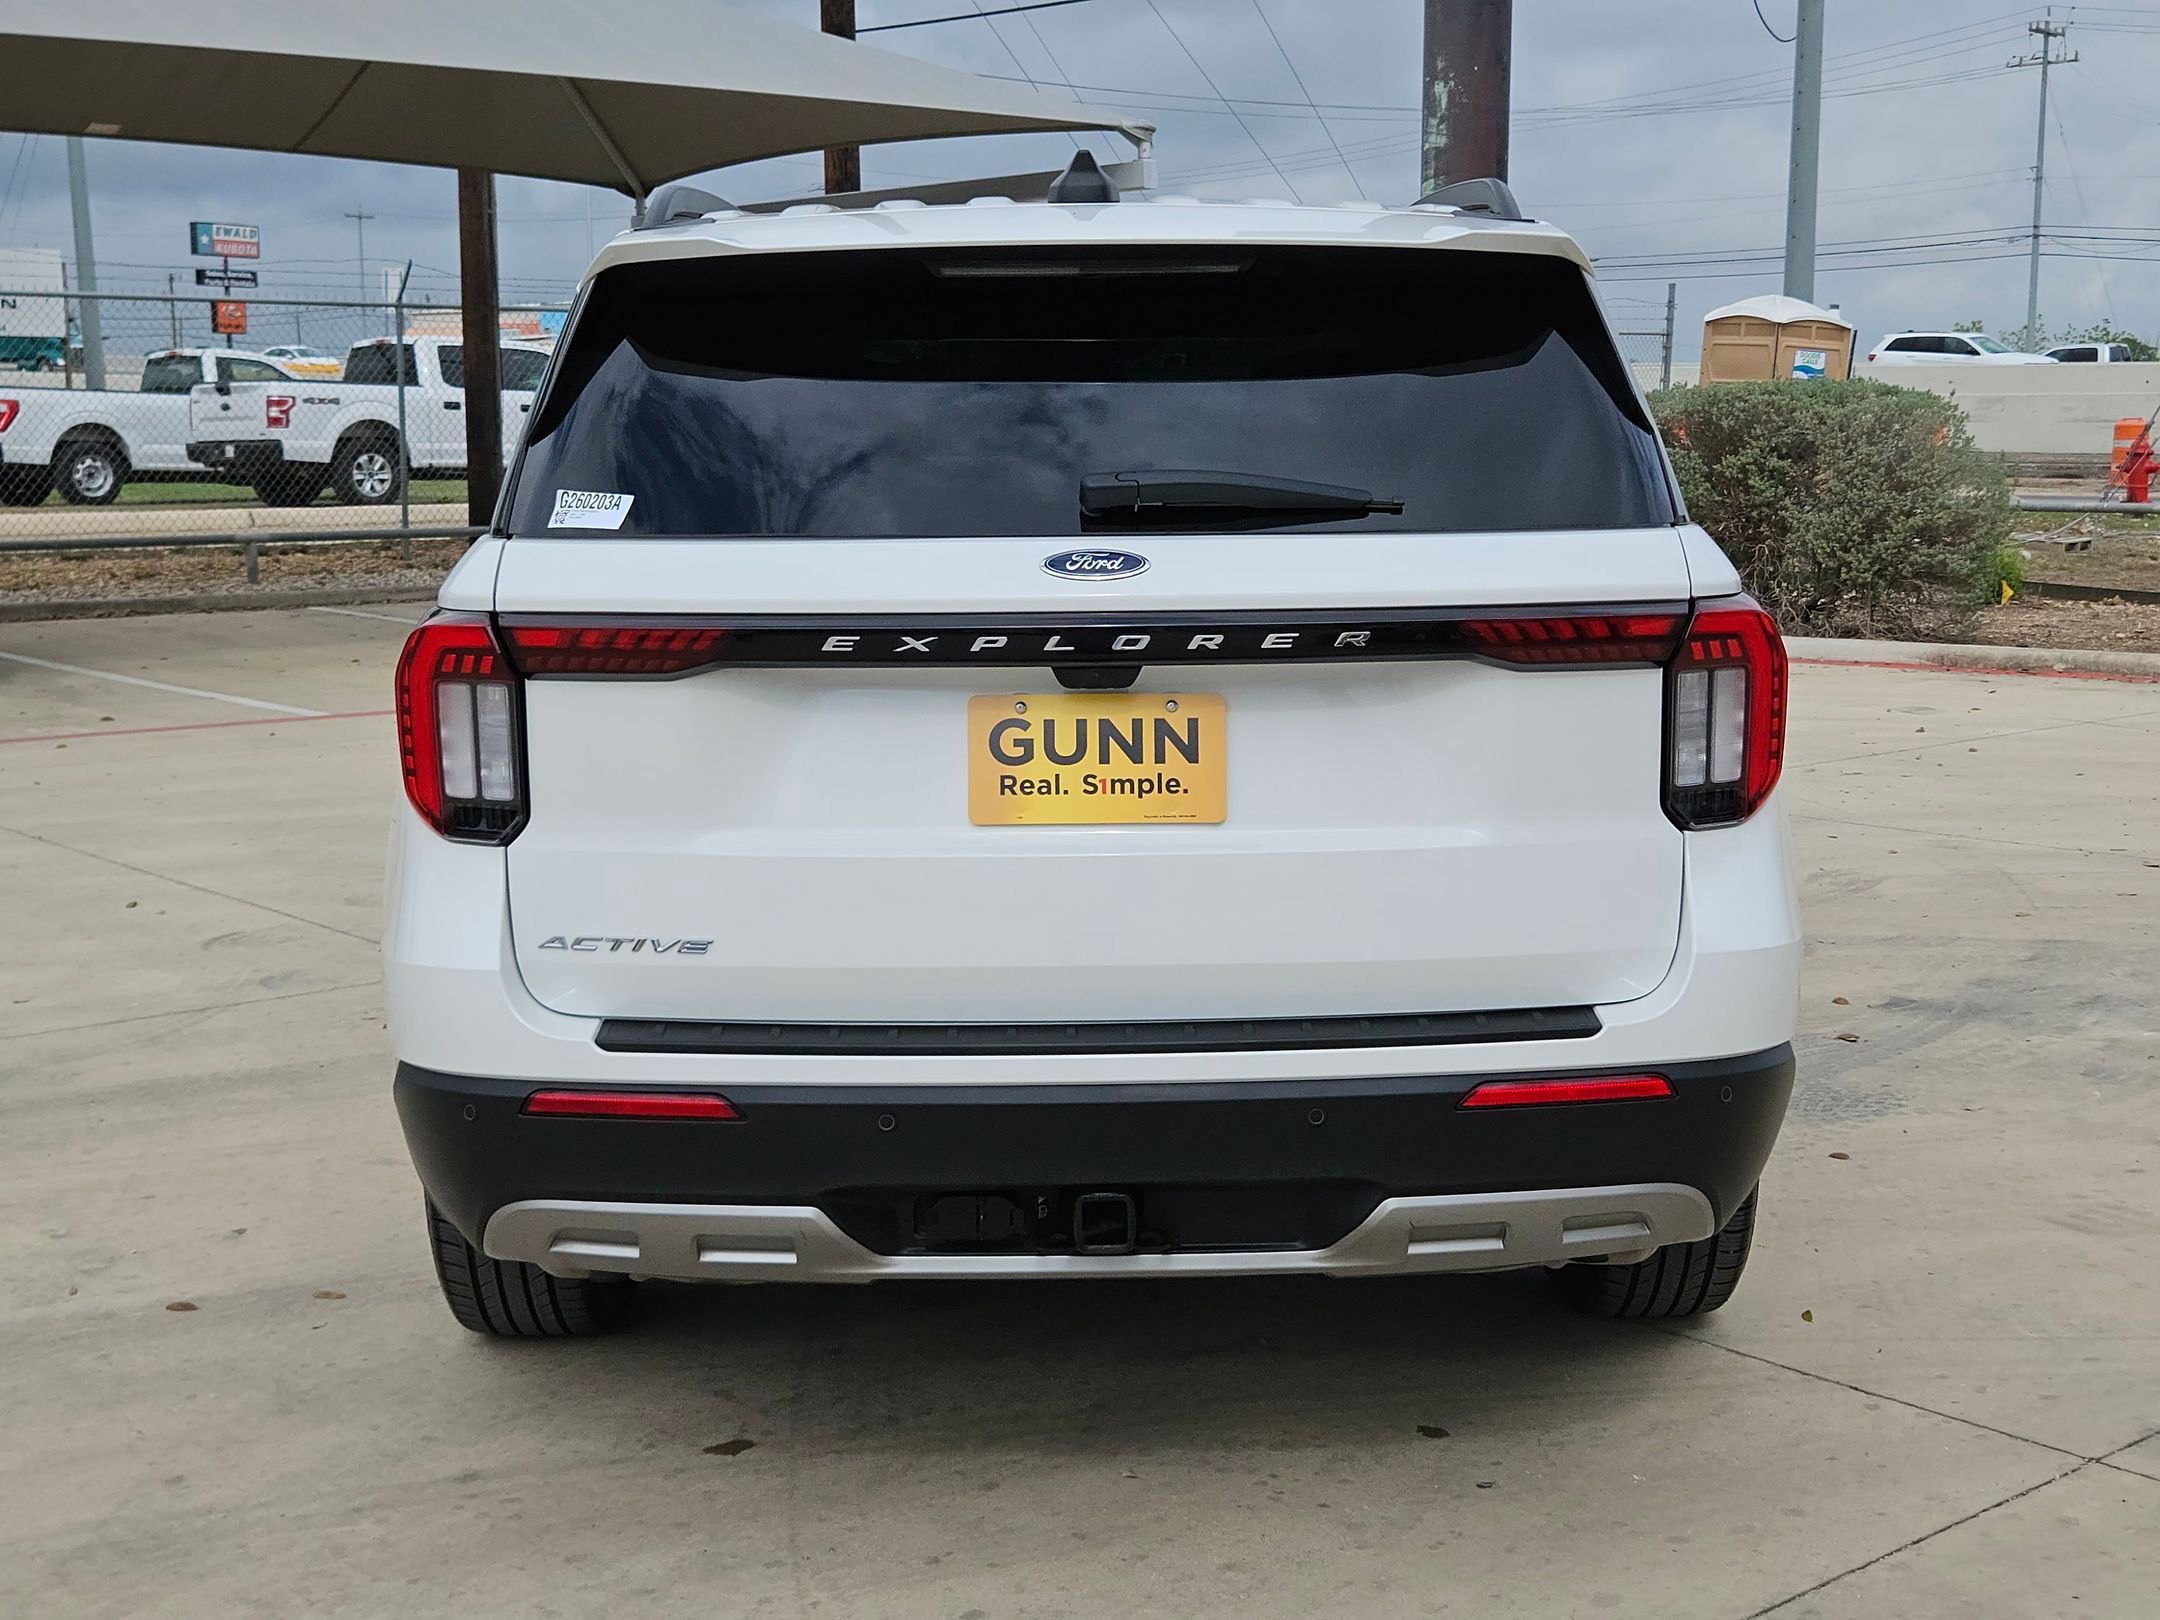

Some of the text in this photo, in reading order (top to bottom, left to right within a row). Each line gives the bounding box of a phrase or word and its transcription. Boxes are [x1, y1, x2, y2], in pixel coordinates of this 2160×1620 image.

[215, 226, 257, 239] EWALD
[216, 243, 257, 256] KUBOTA
[559, 491, 623, 511] G260203A
[1065, 552, 1125, 571] Ford
[820, 630, 1373, 653] EXPLORER
[988, 717, 1200, 767] GUNN
[999, 773, 1070, 797] Real.
[537, 935, 715, 955] ACTIVE
